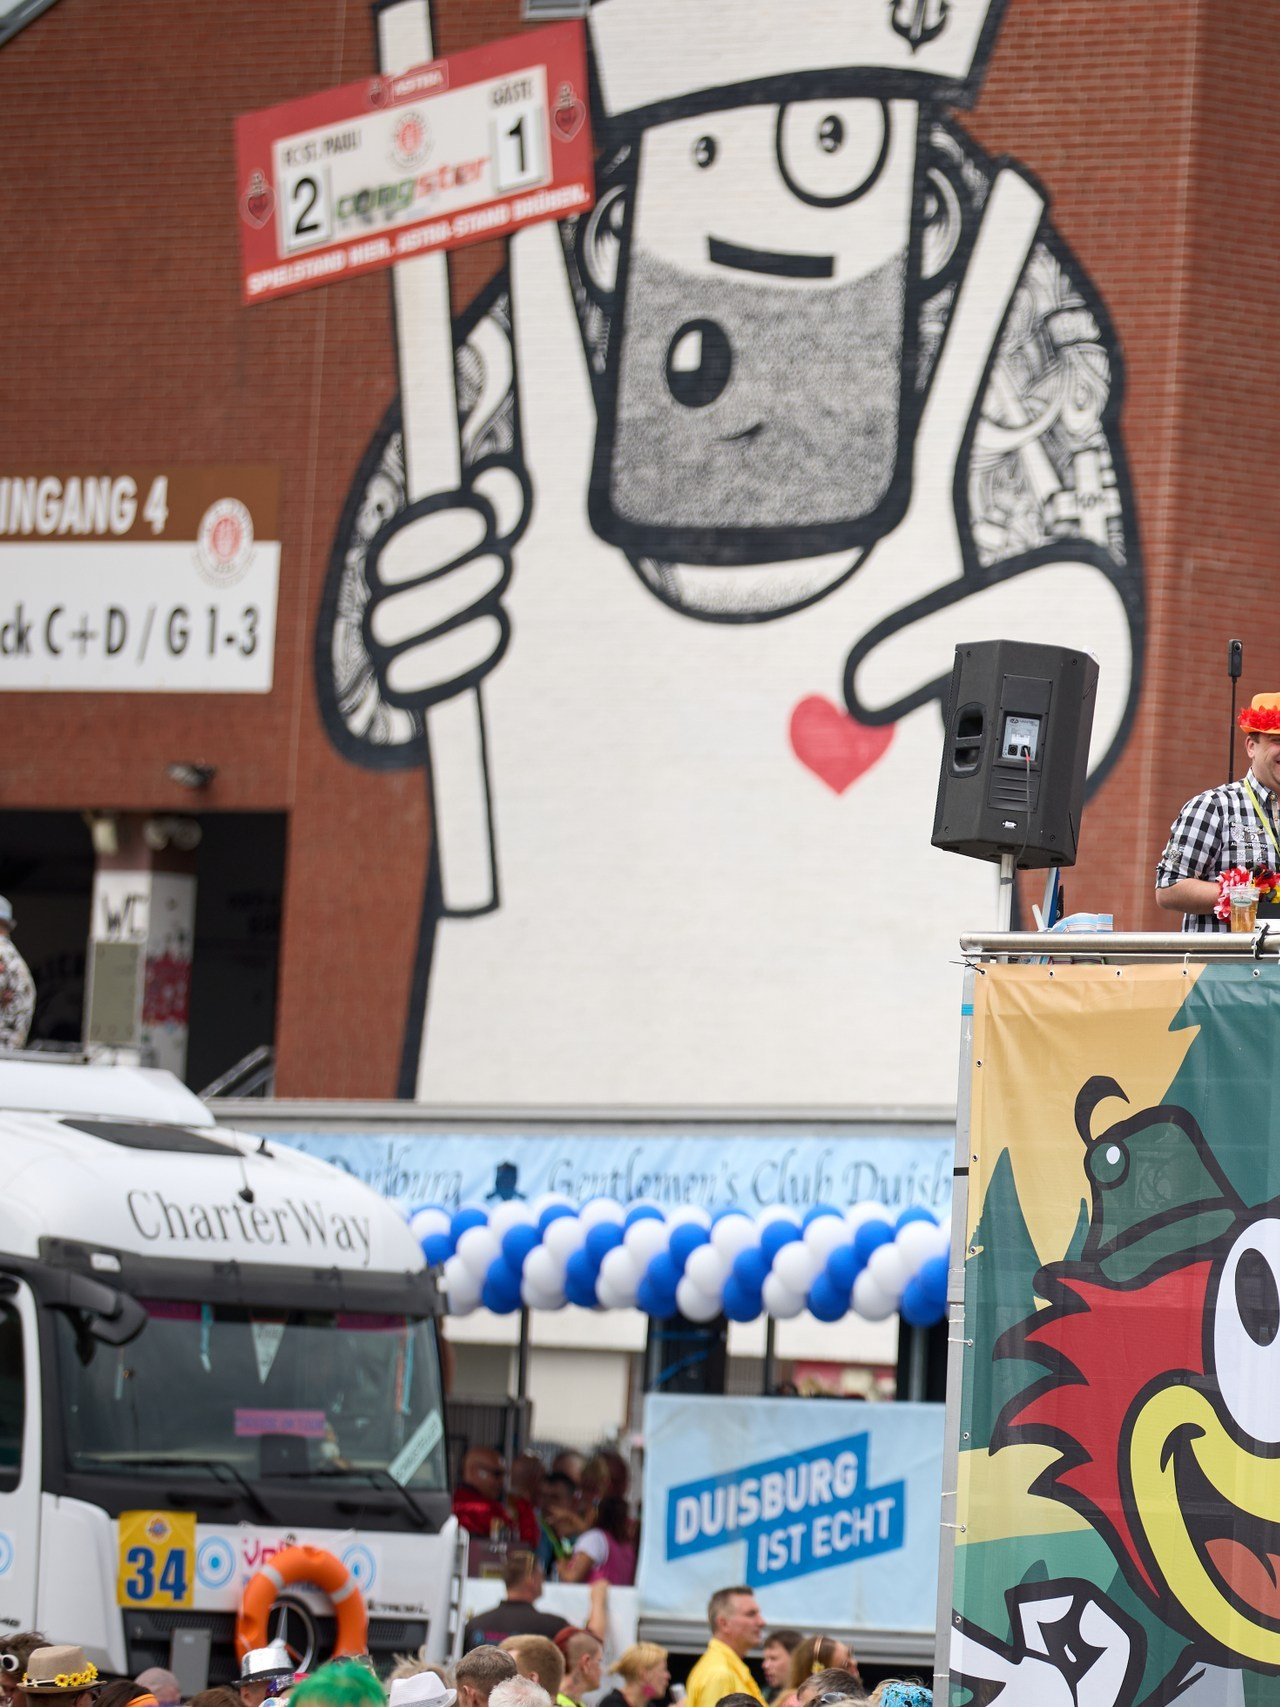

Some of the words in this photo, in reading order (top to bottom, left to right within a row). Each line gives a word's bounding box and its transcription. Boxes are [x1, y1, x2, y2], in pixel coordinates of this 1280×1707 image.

[323, 131, 362, 154] PAULI
[508, 116, 526, 173] 1
[292, 177, 320, 235] 2
[247, 250, 347, 296] SPIELSTAND
[142, 475, 169, 536] 4
[166, 604, 190, 658] G
[208, 604, 260, 658] 1-3
[549, 1147, 738, 1205] Gentlemen's
[751, 1147, 833, 1206] Club
[127, 1188, 372, 1266] CharterWay
[675, 1450, 860, 1546] DUISBURG
[756, 1522, 806, 1574] IST
[812, 1496, 896, 1559] ECHT
[126, 1546, 188, 1601] 34
